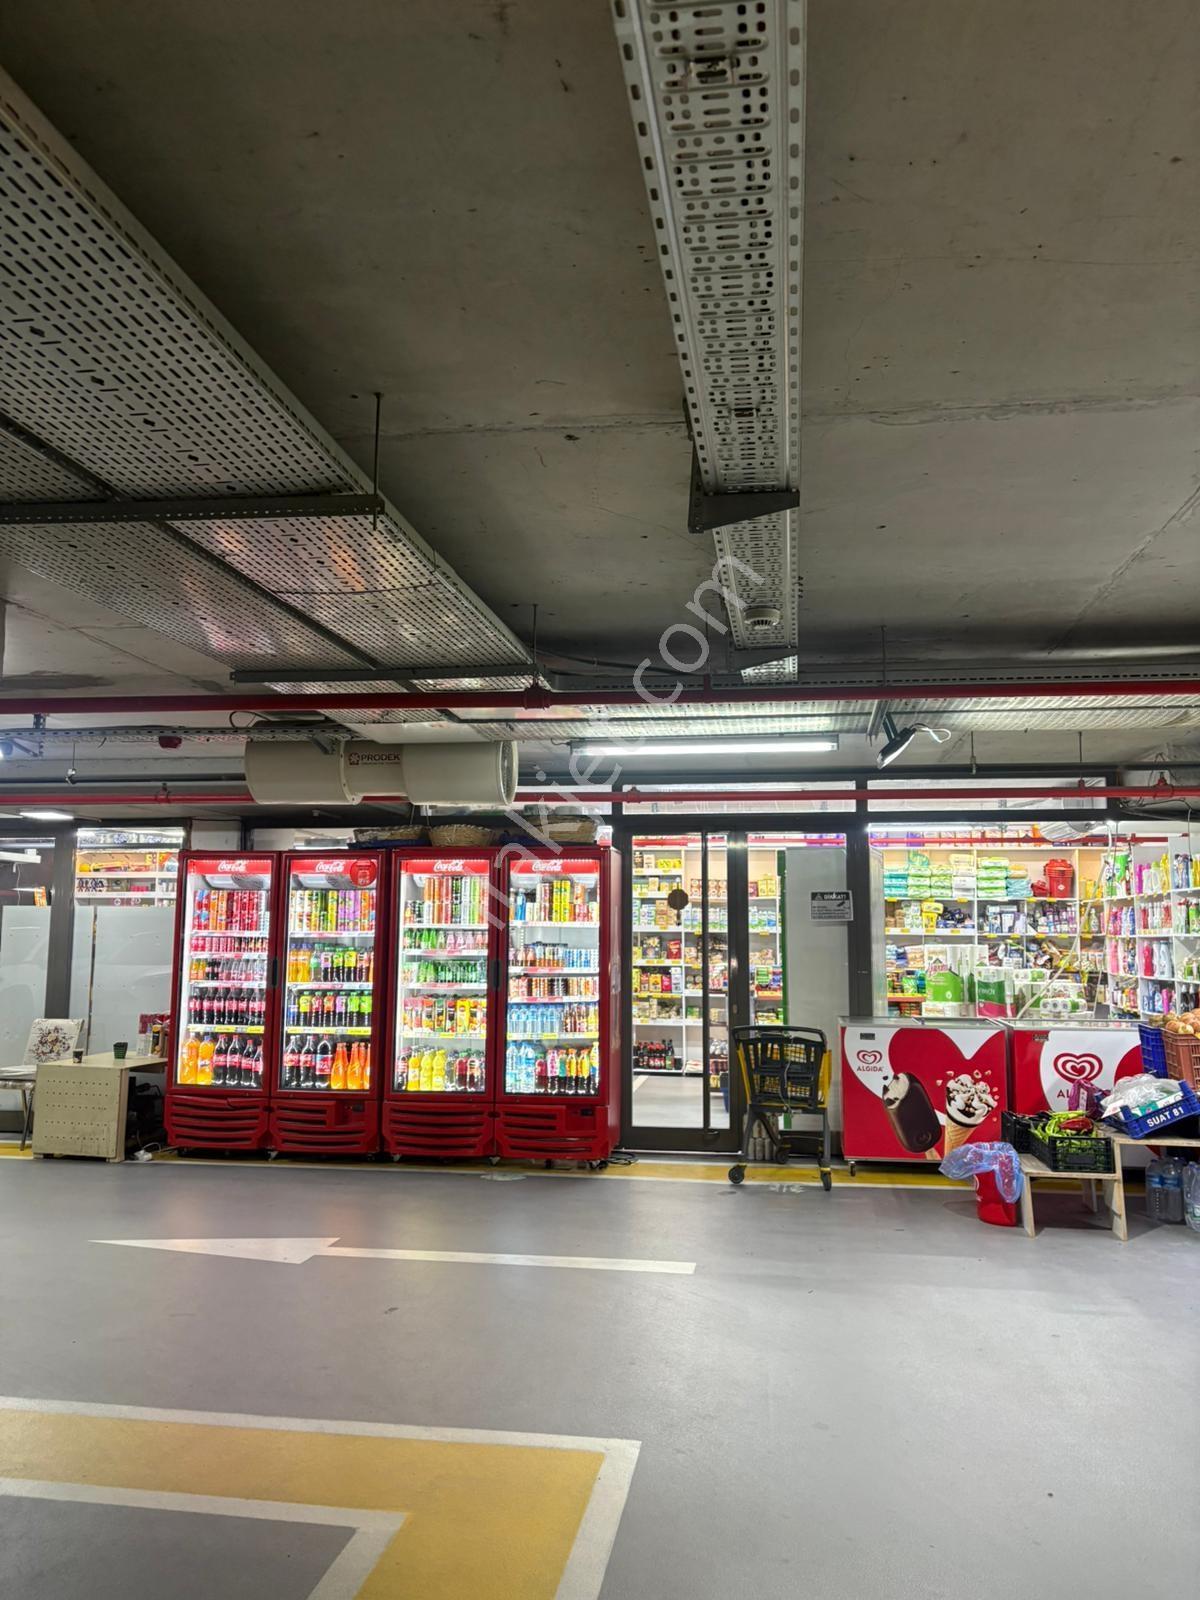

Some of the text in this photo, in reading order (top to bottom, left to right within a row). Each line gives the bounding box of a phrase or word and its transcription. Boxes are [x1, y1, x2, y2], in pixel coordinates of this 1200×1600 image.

[361, 753, 400, 761] PRODEK
[1147, 1105, 1185, 1127] SUAT 81
